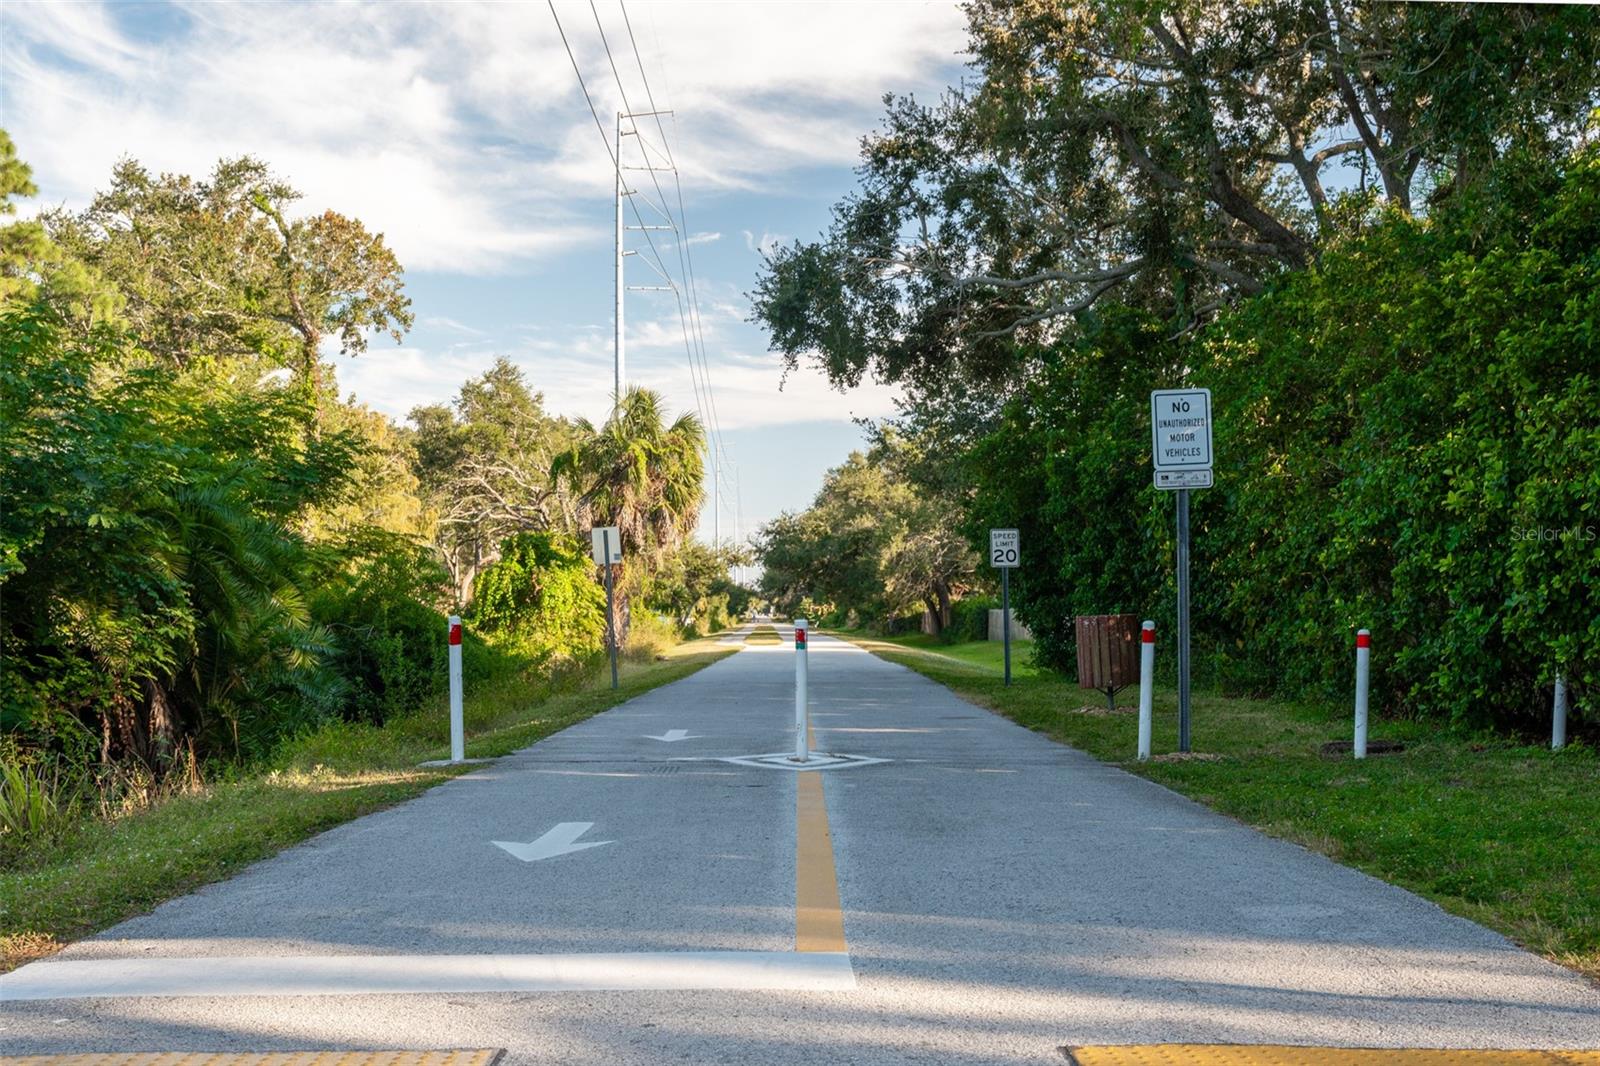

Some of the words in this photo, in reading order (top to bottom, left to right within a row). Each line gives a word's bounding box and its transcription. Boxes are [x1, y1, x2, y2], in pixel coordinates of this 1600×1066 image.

[1172, 401, 1190, 413] NO
[1158, 417, 1205, 429] UNAUTHORIZED
[1169, 433, 1195, 442] MOTOR
[1165, 447, 1201, 457] VEHICLES
[993, 548, 1017, 563] 20
